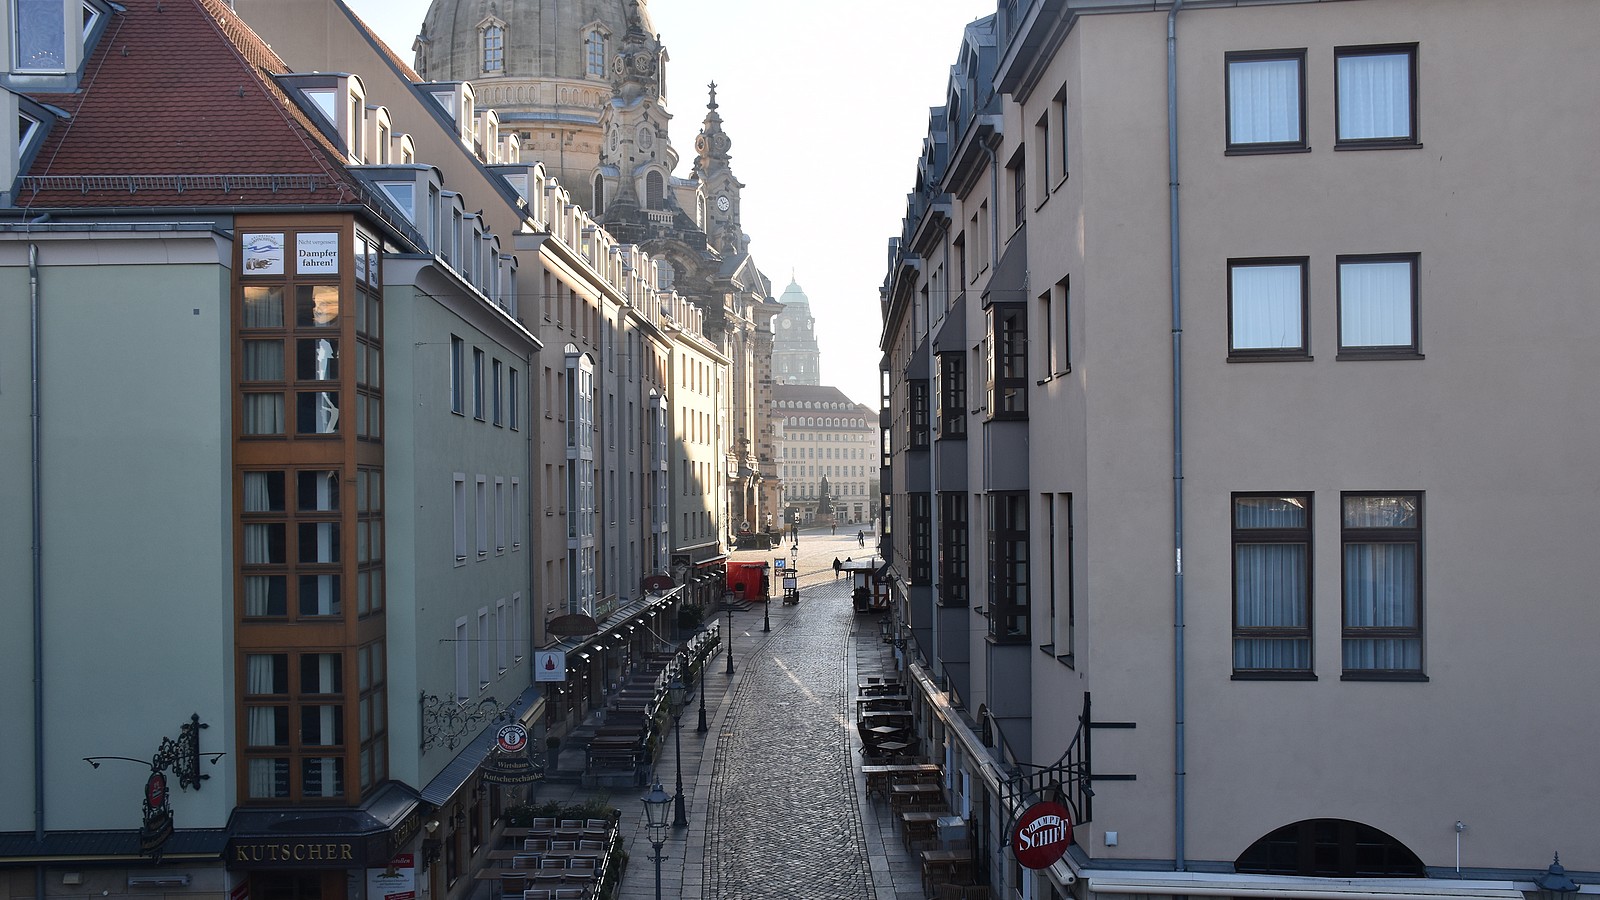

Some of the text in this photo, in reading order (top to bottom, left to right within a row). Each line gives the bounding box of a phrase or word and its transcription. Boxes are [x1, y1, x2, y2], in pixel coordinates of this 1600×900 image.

[299, 249, 337, 258] Dampfer
[302, 258, 333, 266] fahren!
[500, 726, 525, 737] ERDINGER
[483, 772, 543, 783] Kutscherschänke
[1030, 816, 1060, 831] DAMPF
[1019, 818, 1069, 851] SCHIFF
[235, 843, 353, 861] KUTSCHER
